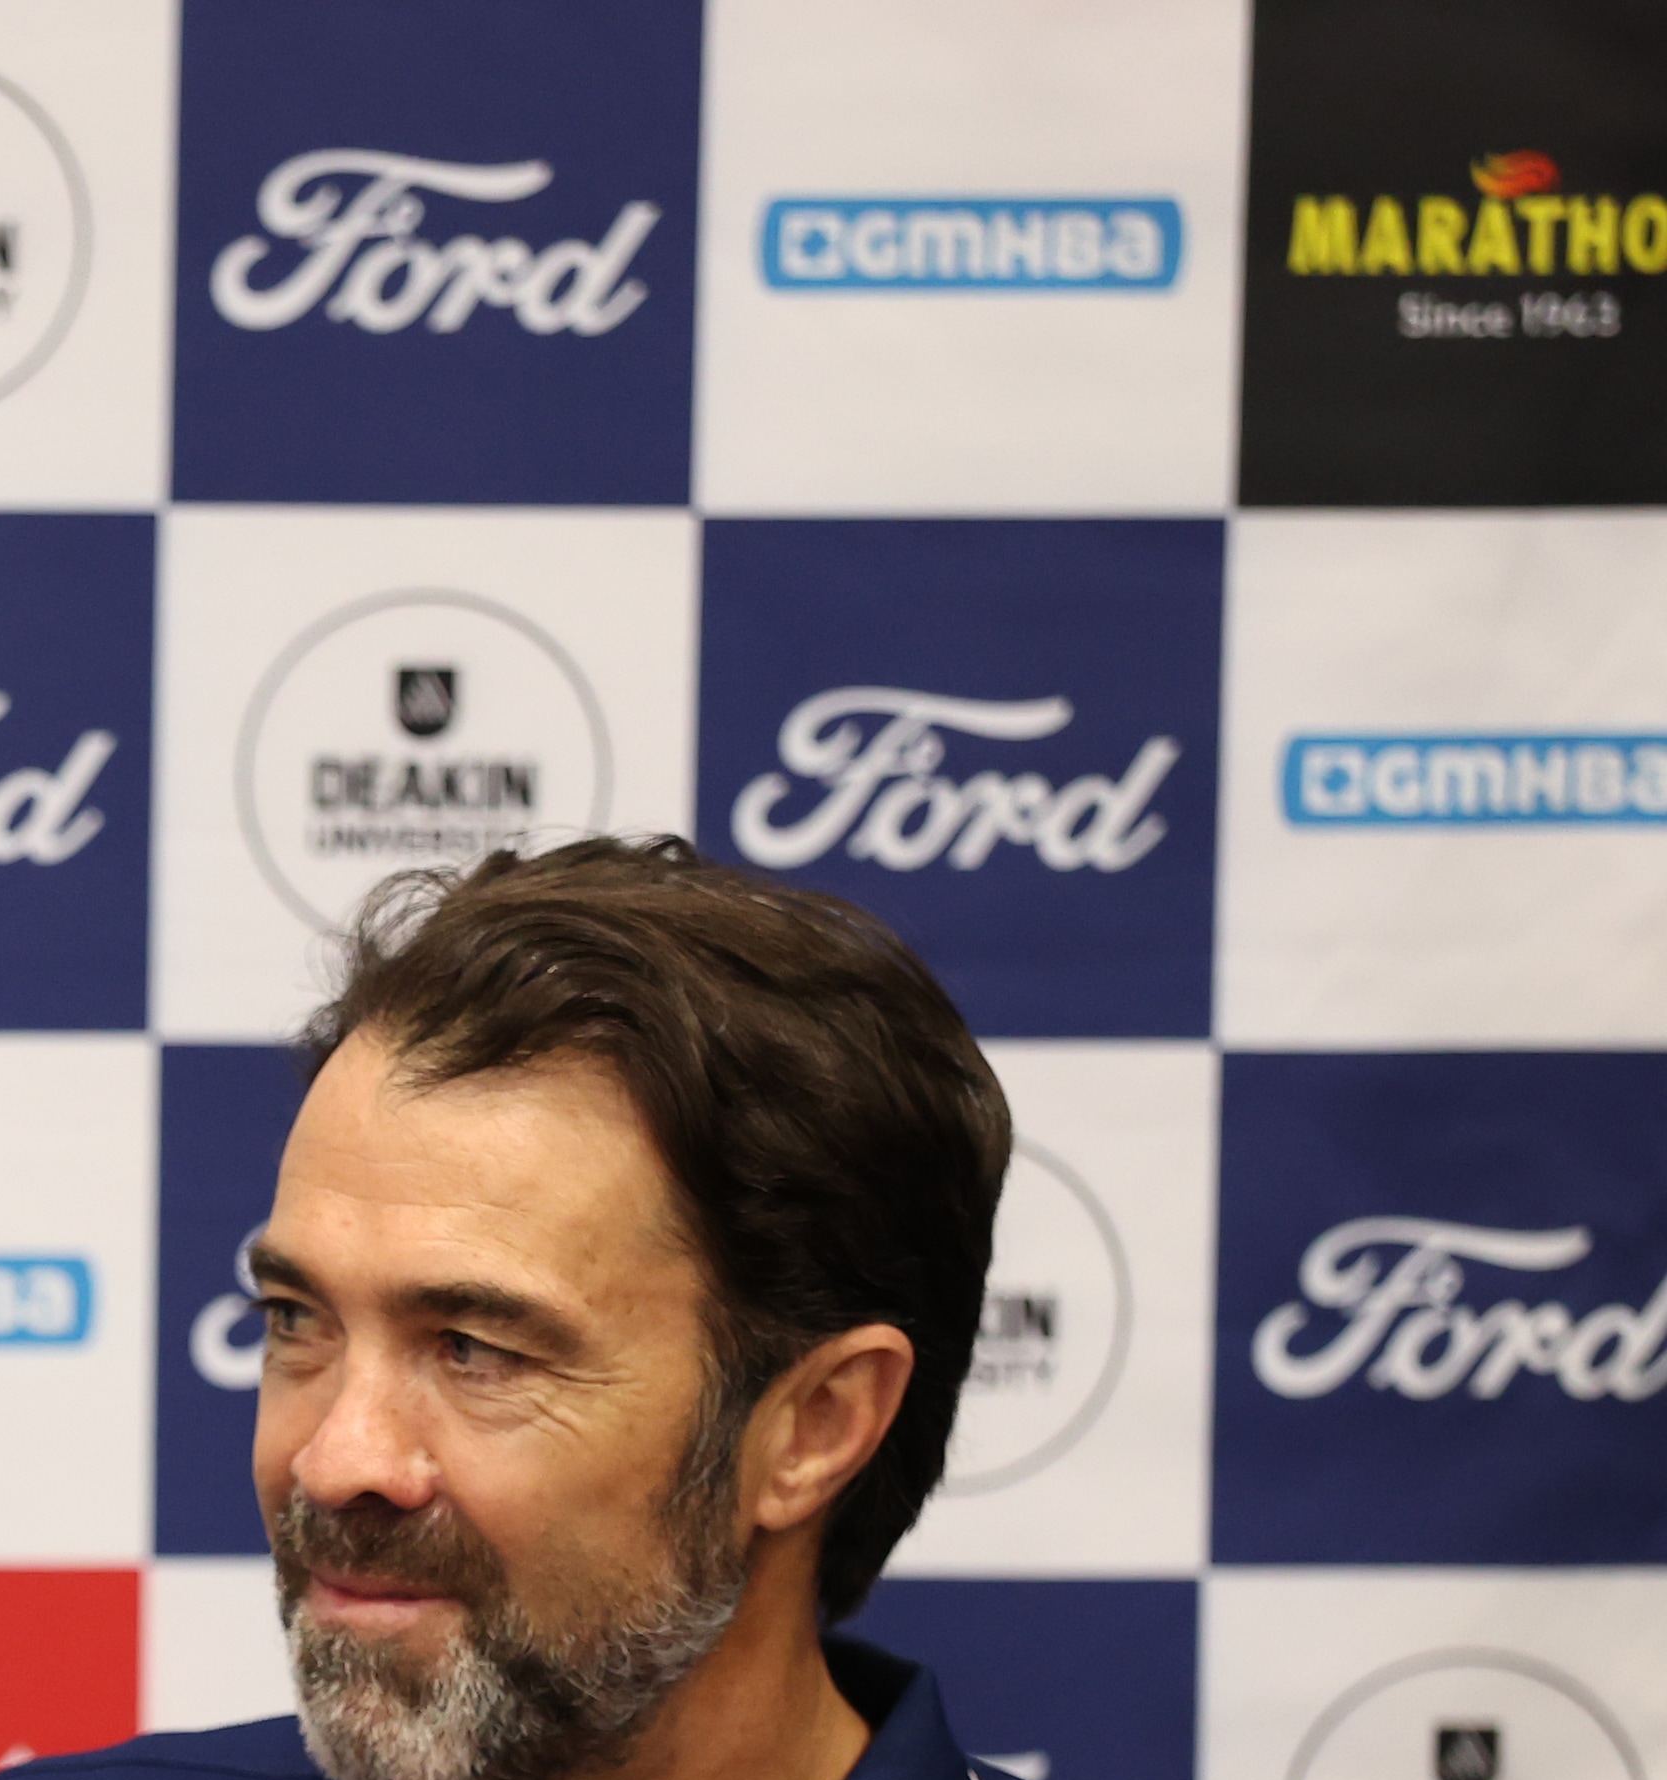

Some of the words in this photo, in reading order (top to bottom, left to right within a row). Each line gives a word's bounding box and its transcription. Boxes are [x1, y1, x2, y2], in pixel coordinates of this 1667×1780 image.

[211, 149, 658, 335] Ford
[1288, 195, 1667, 275] MARATHO
[1398, 293, 1512, 338] Since
[1520, 292, 1620, 337] 1963
[311, 757, 537, 811] DEAKIN
[732, 687, 1178, 871] Ford
[1251, 1215, 1667, 1400] Ford
